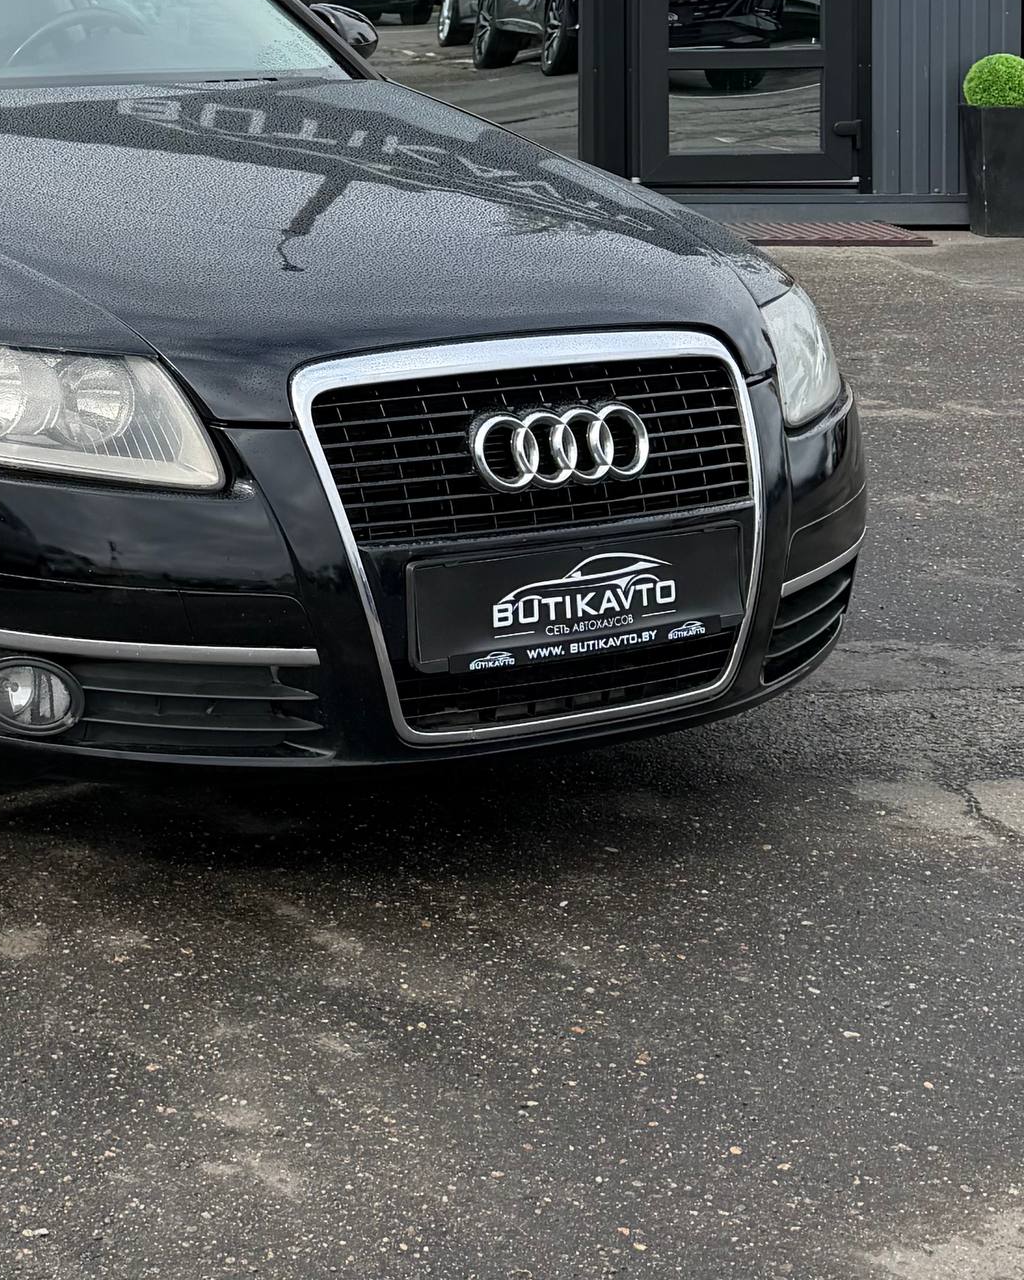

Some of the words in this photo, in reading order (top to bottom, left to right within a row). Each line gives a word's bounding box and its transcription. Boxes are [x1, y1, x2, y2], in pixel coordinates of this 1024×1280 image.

[492, 579, 676, 628] BUTIKAVTO
[545, 623, 570, 637] СЕТЬ
[572, 614, 634, 633] АВТОХАУСОВ
[668, 627, 706, 640] BUTIKAVTO
[526, 644, 565, 660] WWW.
[570, 630, 658, 654] BUTIKAVTO.BY
[469, 657, 516, 670] BUTIKAVTO
